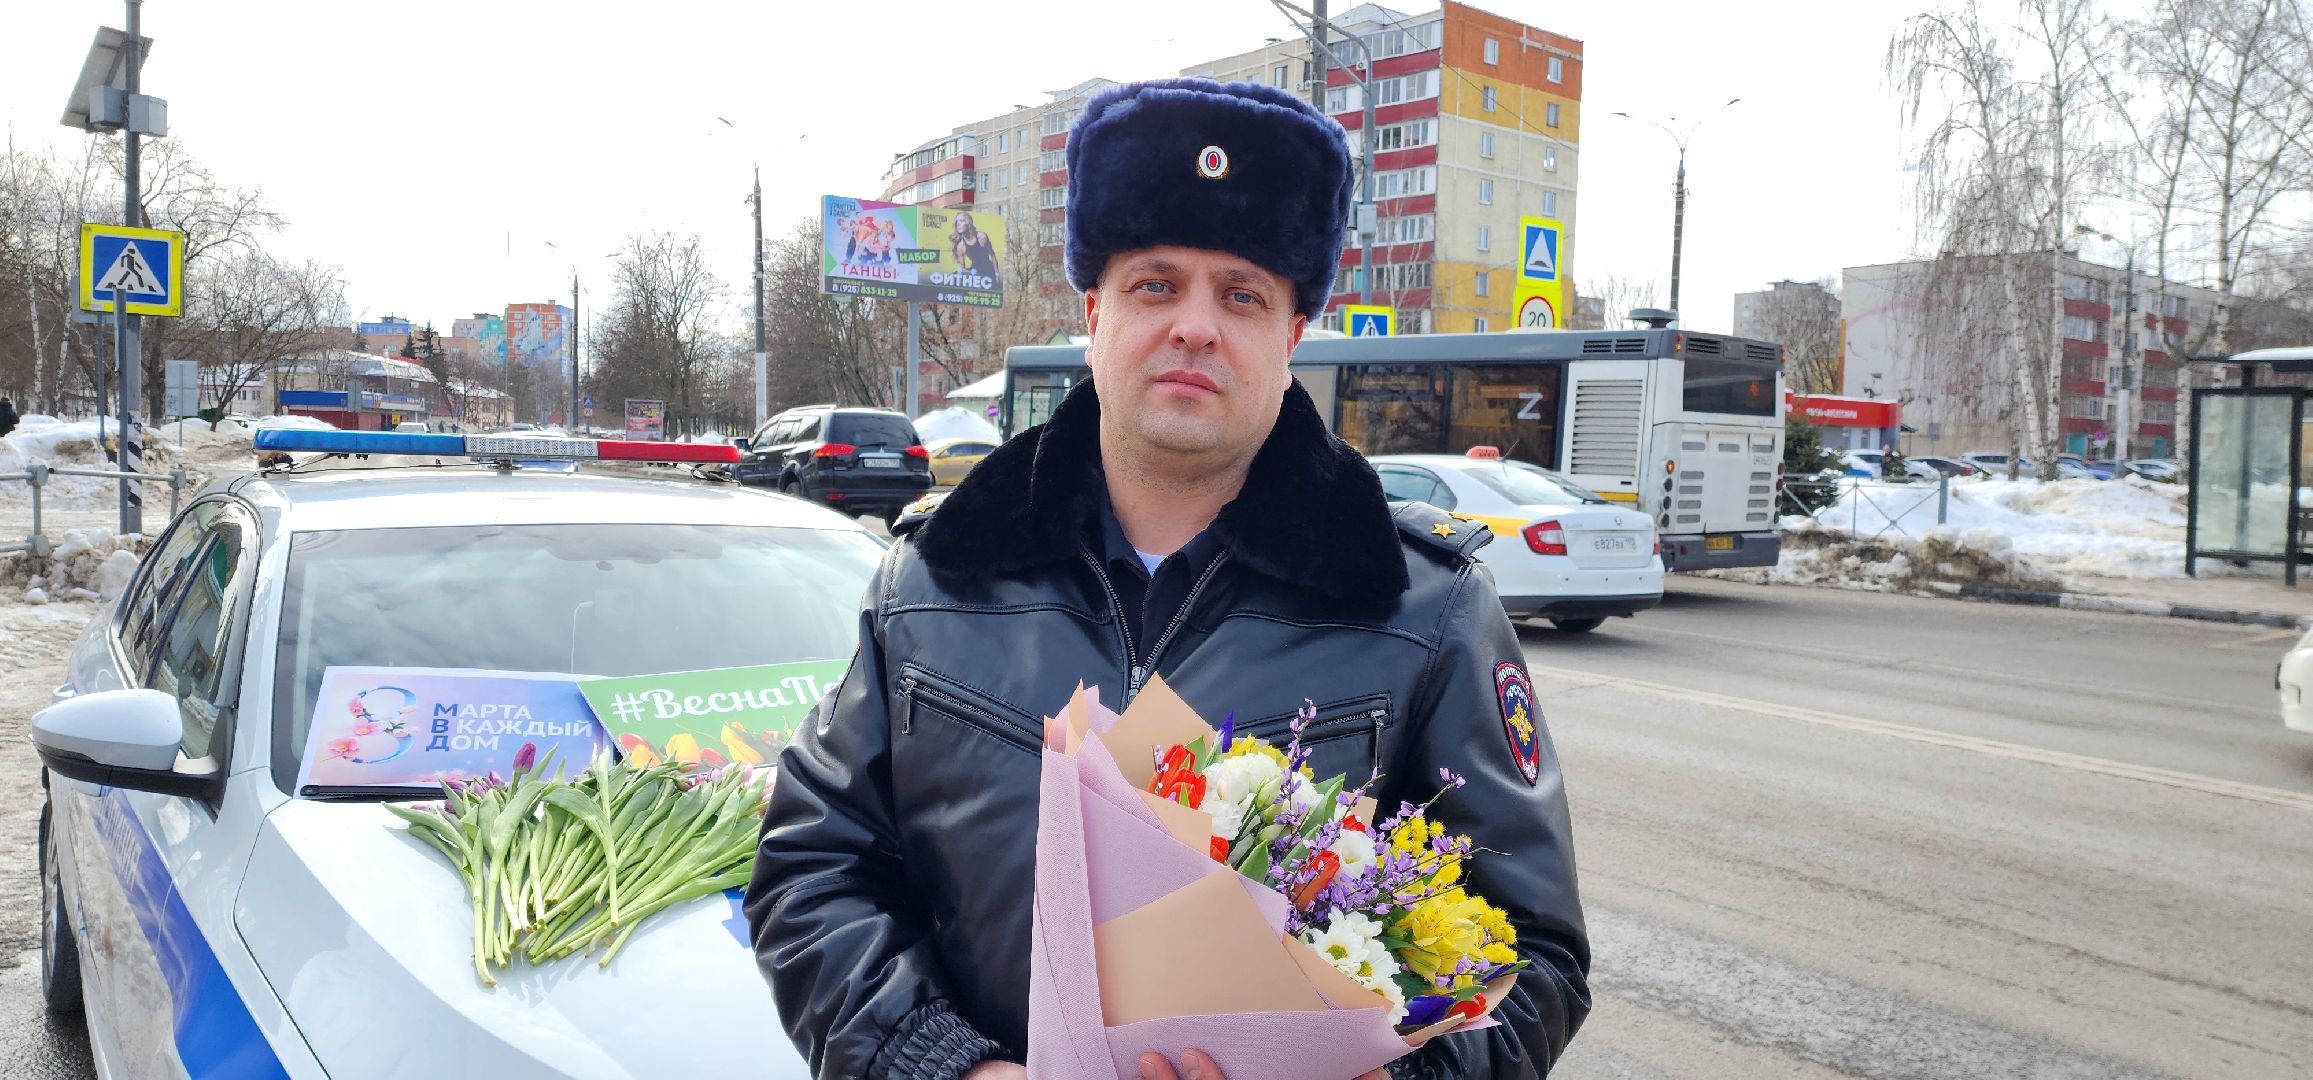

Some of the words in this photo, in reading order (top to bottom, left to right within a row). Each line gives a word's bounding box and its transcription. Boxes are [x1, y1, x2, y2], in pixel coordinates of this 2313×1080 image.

[900, 251, 937, 262] НАБОР
[841, 263, 897, 279] ТАНЦЫ
[929, 272, 993, 290] ФИТНЕС
[1517, 392, 1543, 420] Z
[433, 703, 532, 720] МАРТА
[430, 718, 449, 734] В
[456, 718, 593, 738] КАЖДЫЙ
[425, 734, 499, 752] ДОМ
